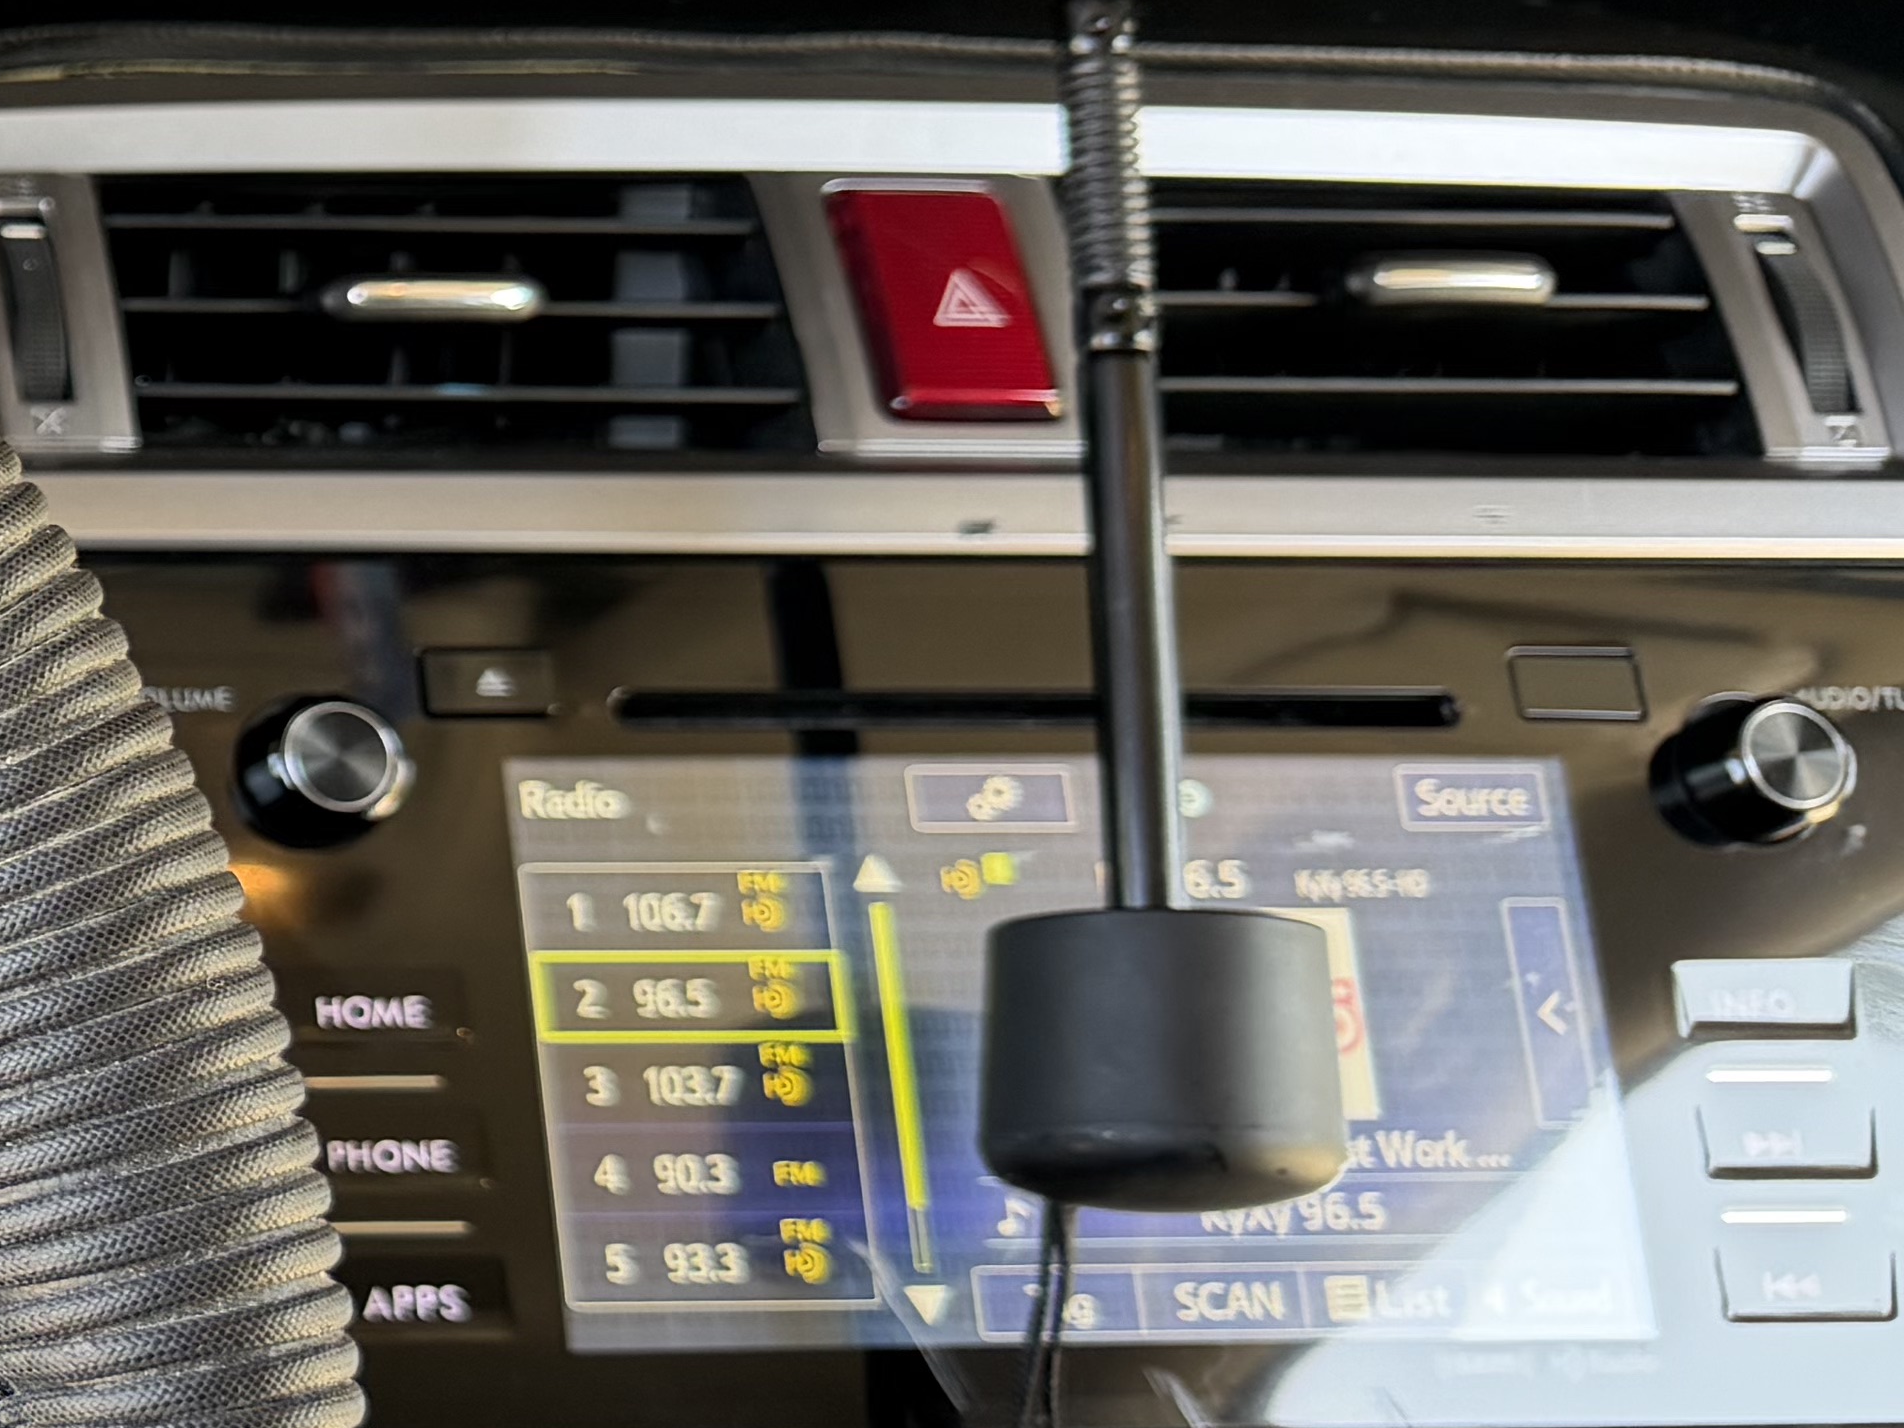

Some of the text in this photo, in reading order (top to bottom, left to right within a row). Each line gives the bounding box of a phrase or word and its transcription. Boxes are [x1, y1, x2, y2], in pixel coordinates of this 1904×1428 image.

[518, 780, 630, 819] Radio
[1414, 778, 1531, 817] Source
[1183, 859, 1248, 899] 6.5
[567, 892, 594, 932] 1
[623, 892, 722, 932] 106.7
[315, 995, 433, 1029] HOME
[573, 979, 610, 1018] 2
[633, 978, 720, 1018] 96.5
[583, 1065, 620, 1106] 3
[643, 1065, 744, 1106] 103.7
[327, 1139, 459, 1173] PHONE
[594, 1153, 632, 1195] 4
[653, 1153, 739, 1195] 90.3
[1298, 1191, 1387, 1232] 96.5
[604, 1242, 640, 1285] 5
[663, 1242, 749, 1285] 93.3
[363, 1284, 473, 1323] APPS
[1174, 1281, 1285, 1321] SCAN
